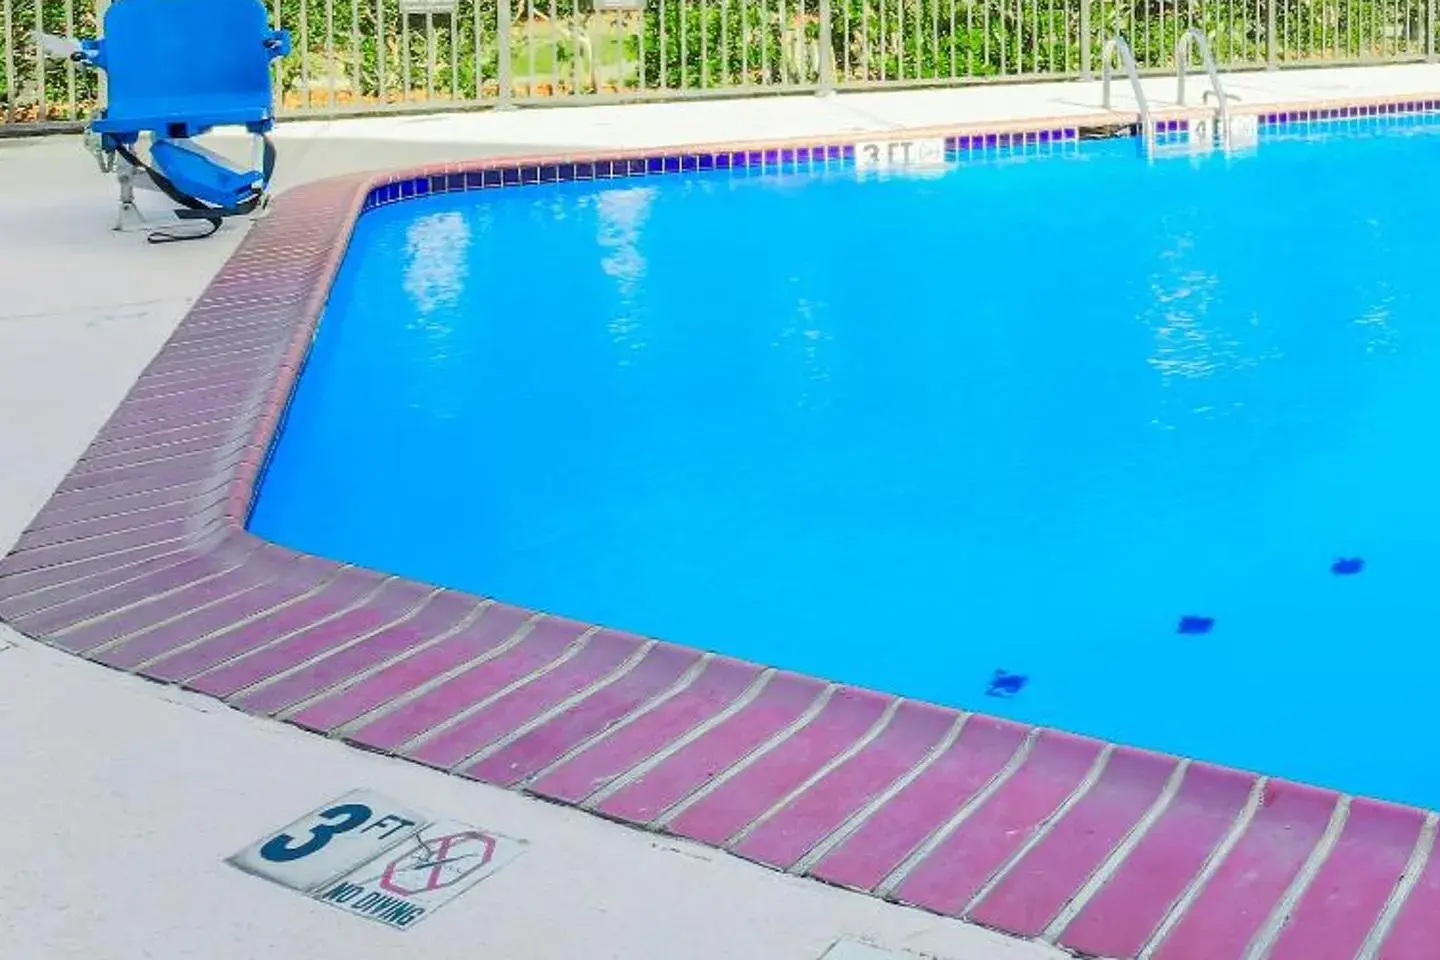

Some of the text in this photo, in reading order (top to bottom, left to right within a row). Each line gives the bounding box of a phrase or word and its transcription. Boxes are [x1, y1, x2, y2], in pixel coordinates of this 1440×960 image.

[863, 142, 913, 164] 3 FT
[260, 803, 415, 862] 3 FT
[323, 880, 425, 926] NO DIVING
